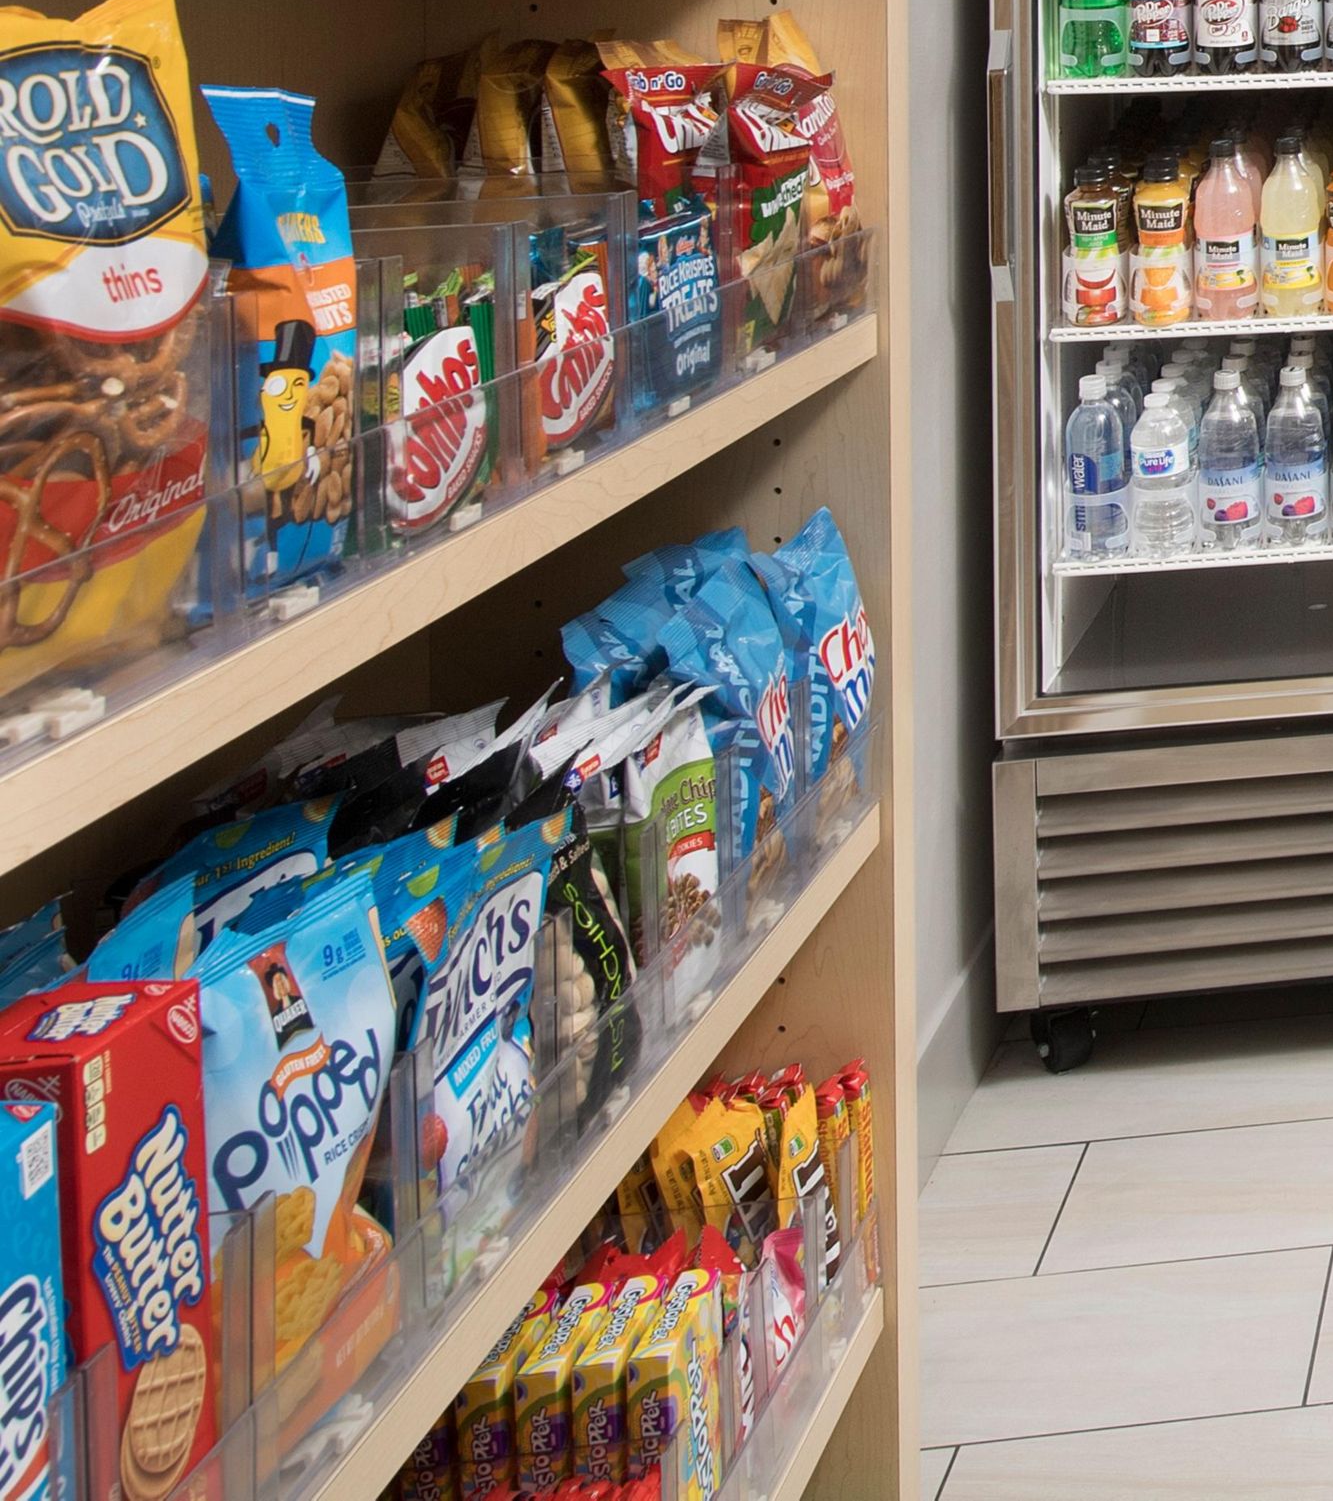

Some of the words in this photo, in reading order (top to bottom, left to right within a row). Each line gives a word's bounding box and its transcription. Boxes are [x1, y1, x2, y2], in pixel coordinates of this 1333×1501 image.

[664, 72, 685, 90] Go
[6, 132, 168, 222] GOLD
[1076, 210, 1112, 222] Minute
[1081, 220, 1109, 232] Maid
[1140, 209, 1180, 221] Minute
[1146, 218, 1176, 230] Maid
[1208, 245, 1237, 255] Minute
[102, 265, 163, 303] thins
[658, 272, 681, 298] RICE
[678, 256, 715, 284] KRISPIES
[676, 341, 711, 377] original
[1207, 476, 1244, 488] DASANI
[1275, 471, 1312, 483] DASANI
[108, 471, 206, 533] Original
[272, 998, 309, 1034] QUAKER
[275, 1057, 305, 1088] GLUTEN
[323, 1136, 349, 1167] RICE
[134, 1111, 203, 1304] Nutter
[99, 1174, 180, 1354] Butter
